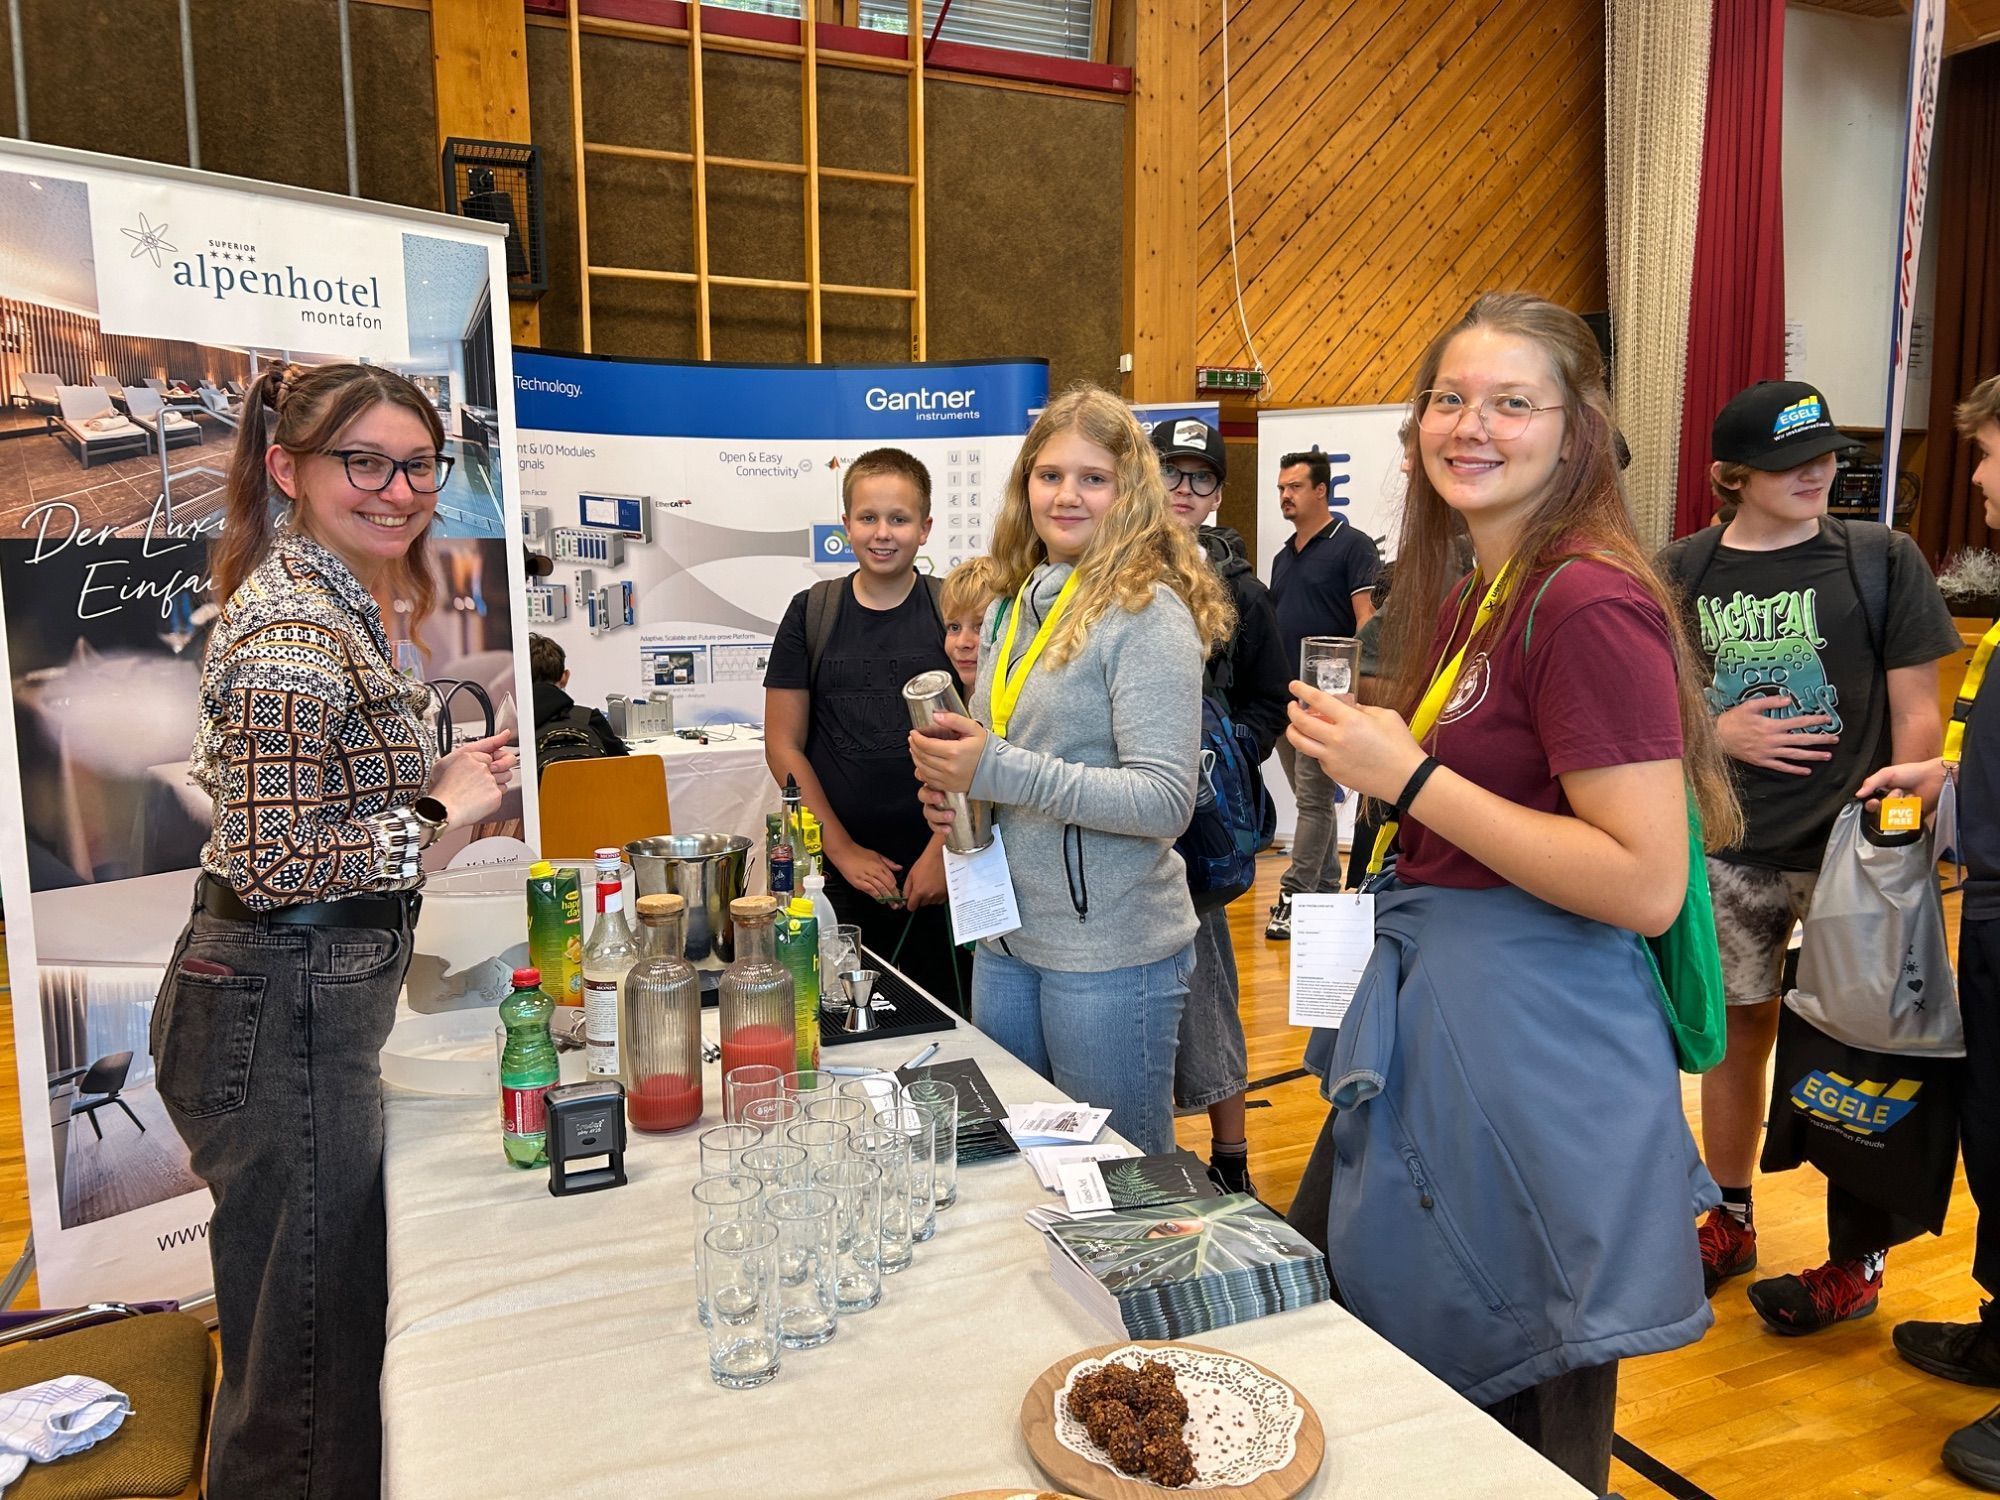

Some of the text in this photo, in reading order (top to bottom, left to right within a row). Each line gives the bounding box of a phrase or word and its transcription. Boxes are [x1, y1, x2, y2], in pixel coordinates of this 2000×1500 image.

[208, 239, 256, 252] SUPERIOR
[173, 254, 382, 309] alpenhotel
[301, 309, 383, 330] montafon
[514, 375, 583, 398] Technology.
[865, 387, 975, 411] Gantner
[916, 410, 980, 421] instruments
[1780, 406, 1820, 424] EGELE
[530, 444, 537, 454] &
[540, 444, 553, 455] I/O
[556, 446, 596, 458] Modules
[519, 459, 545, 471] gnals
[719, 452, 783, 465] Open & Easy
[736, 466, 799, 478] Connectivity
[21, 502, 119, 564] Der
[1888, 808, 1914, 818] PVC
[1802, 1076, 1890, 1125] EGELE
[1855, 1135, 1886, 1149] Freude
